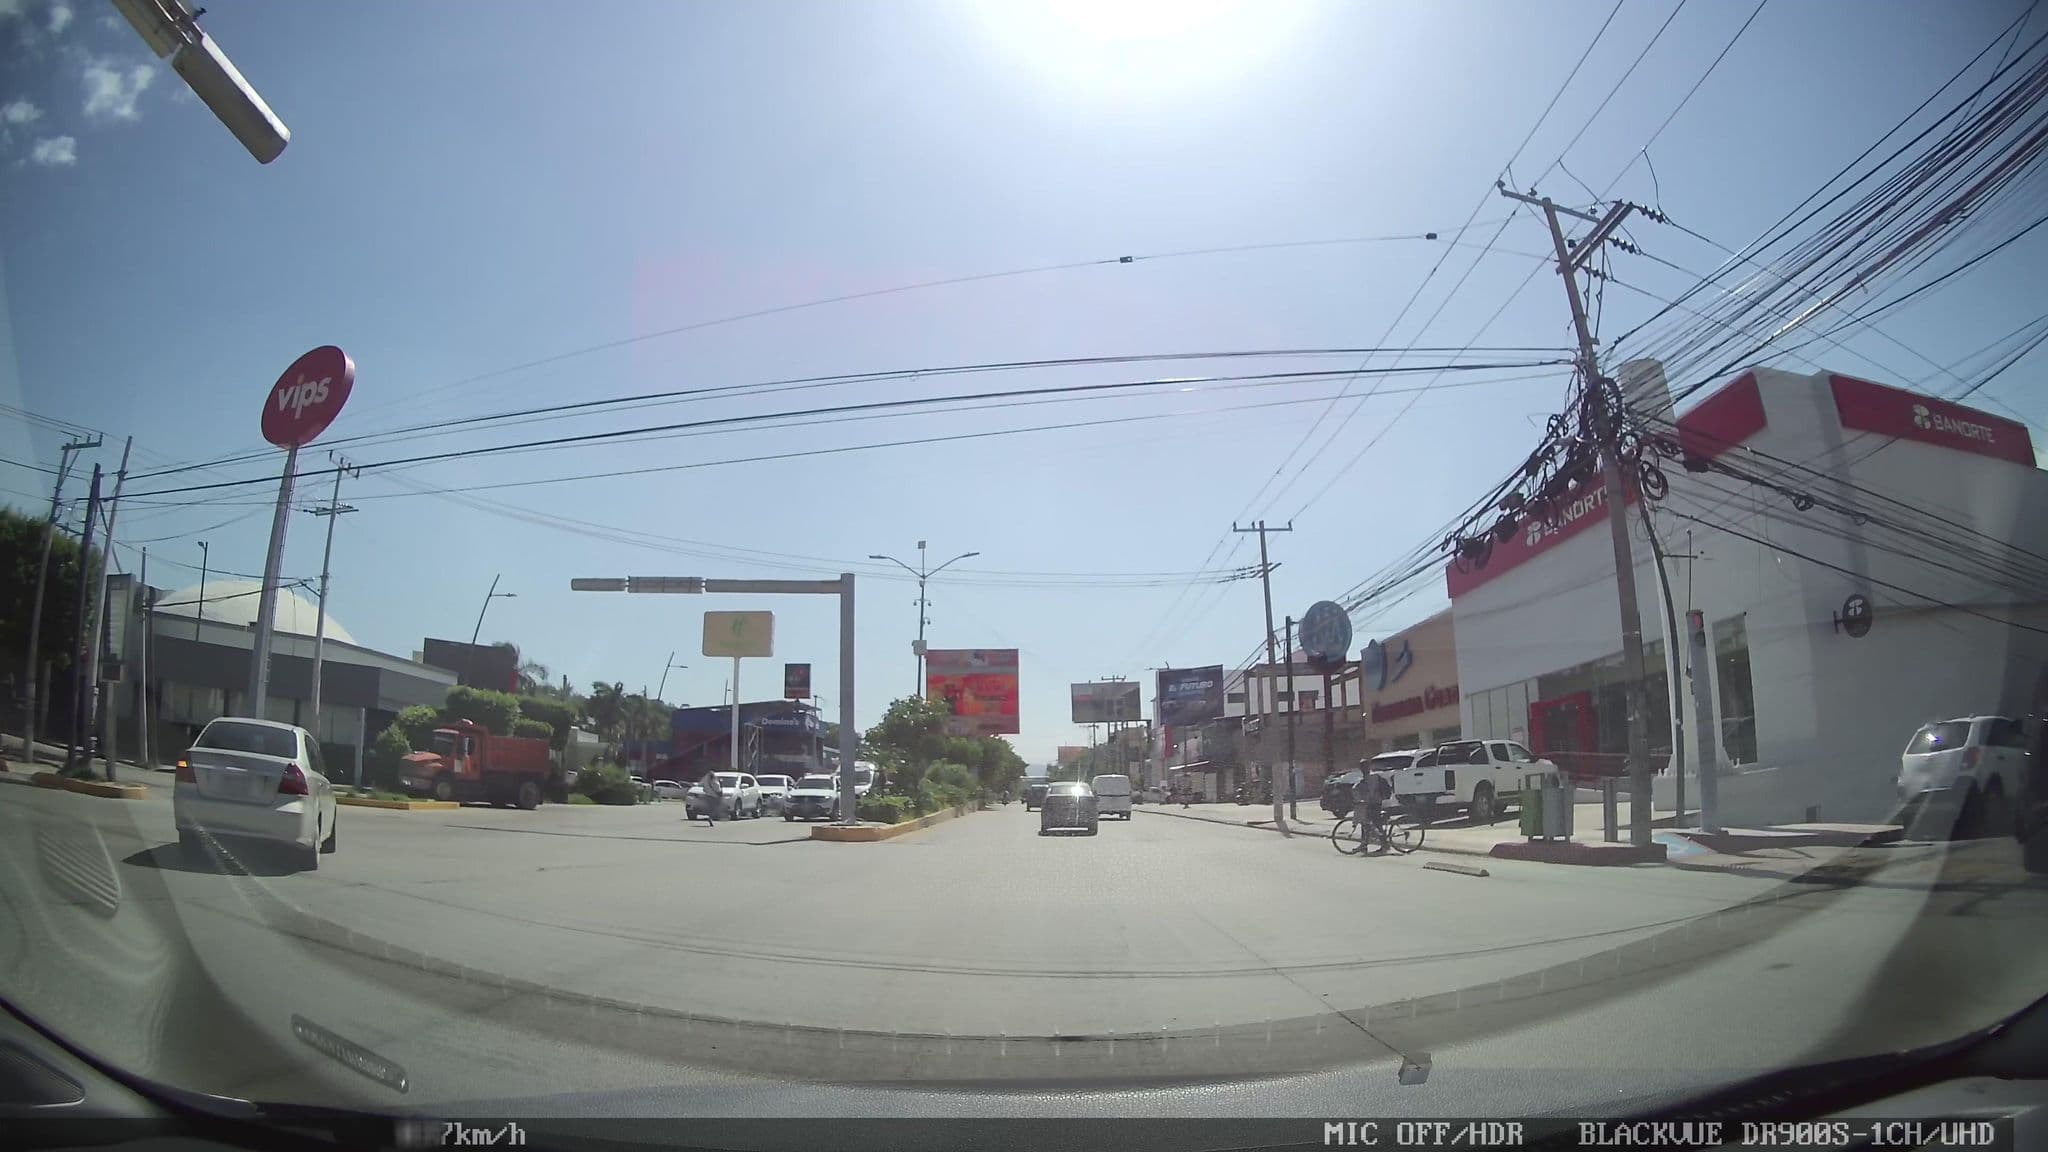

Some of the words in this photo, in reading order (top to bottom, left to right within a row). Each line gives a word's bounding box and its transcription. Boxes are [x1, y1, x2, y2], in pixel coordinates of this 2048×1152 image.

[278, 373, 332, 420] vips
[1933, 414, 1996, 443] BANORTE
[1544, 485, 1609, 536] BNORT
[761, 717, 799, 726] Domino's
